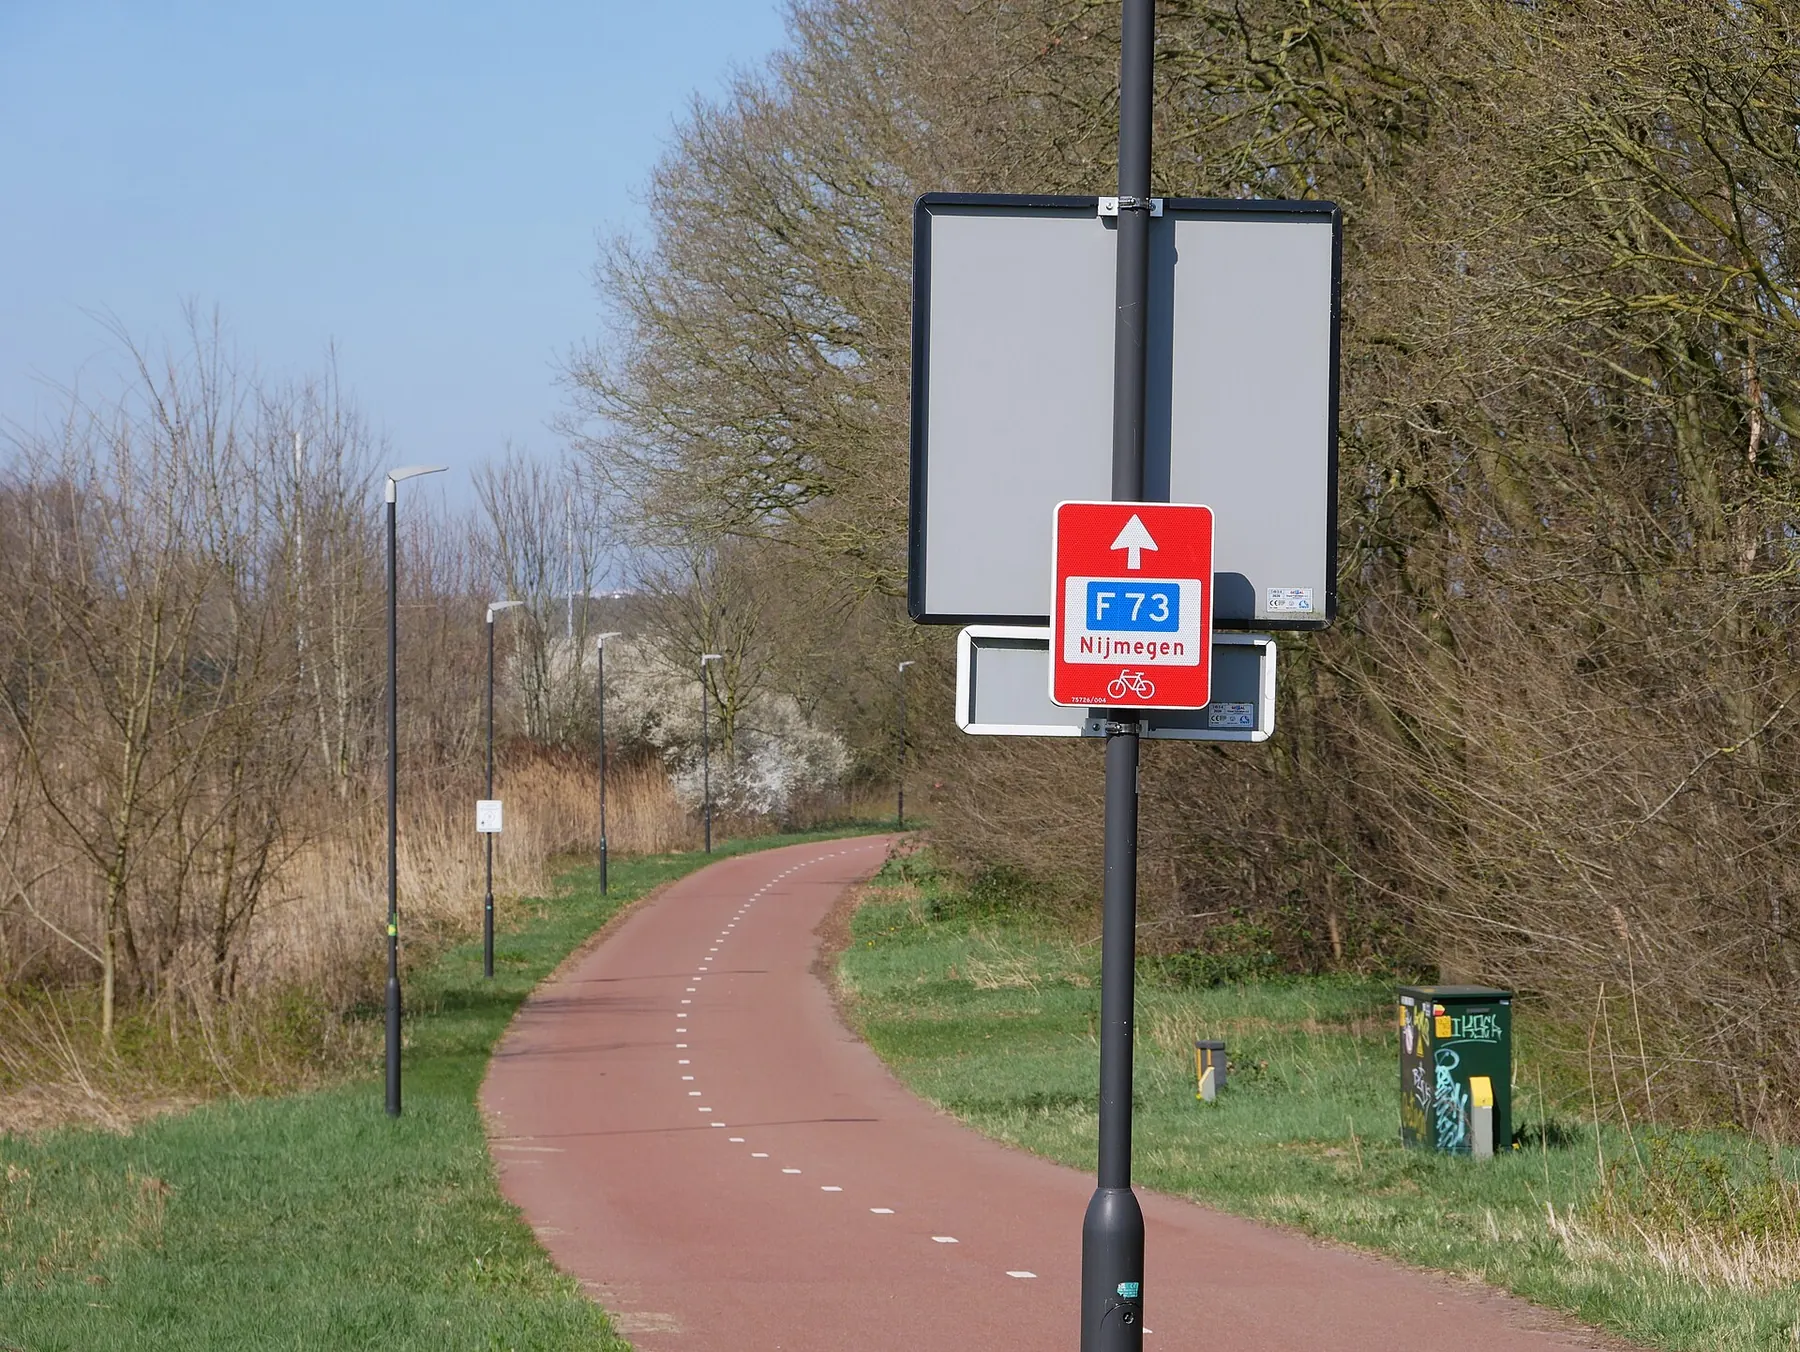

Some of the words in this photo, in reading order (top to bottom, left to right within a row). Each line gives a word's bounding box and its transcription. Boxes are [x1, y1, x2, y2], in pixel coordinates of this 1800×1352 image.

[1096, 592, 1116, 621] F
[1125, 592, 1170, 622] 73
[1080, 636, 1185, 660] Nijmegen
